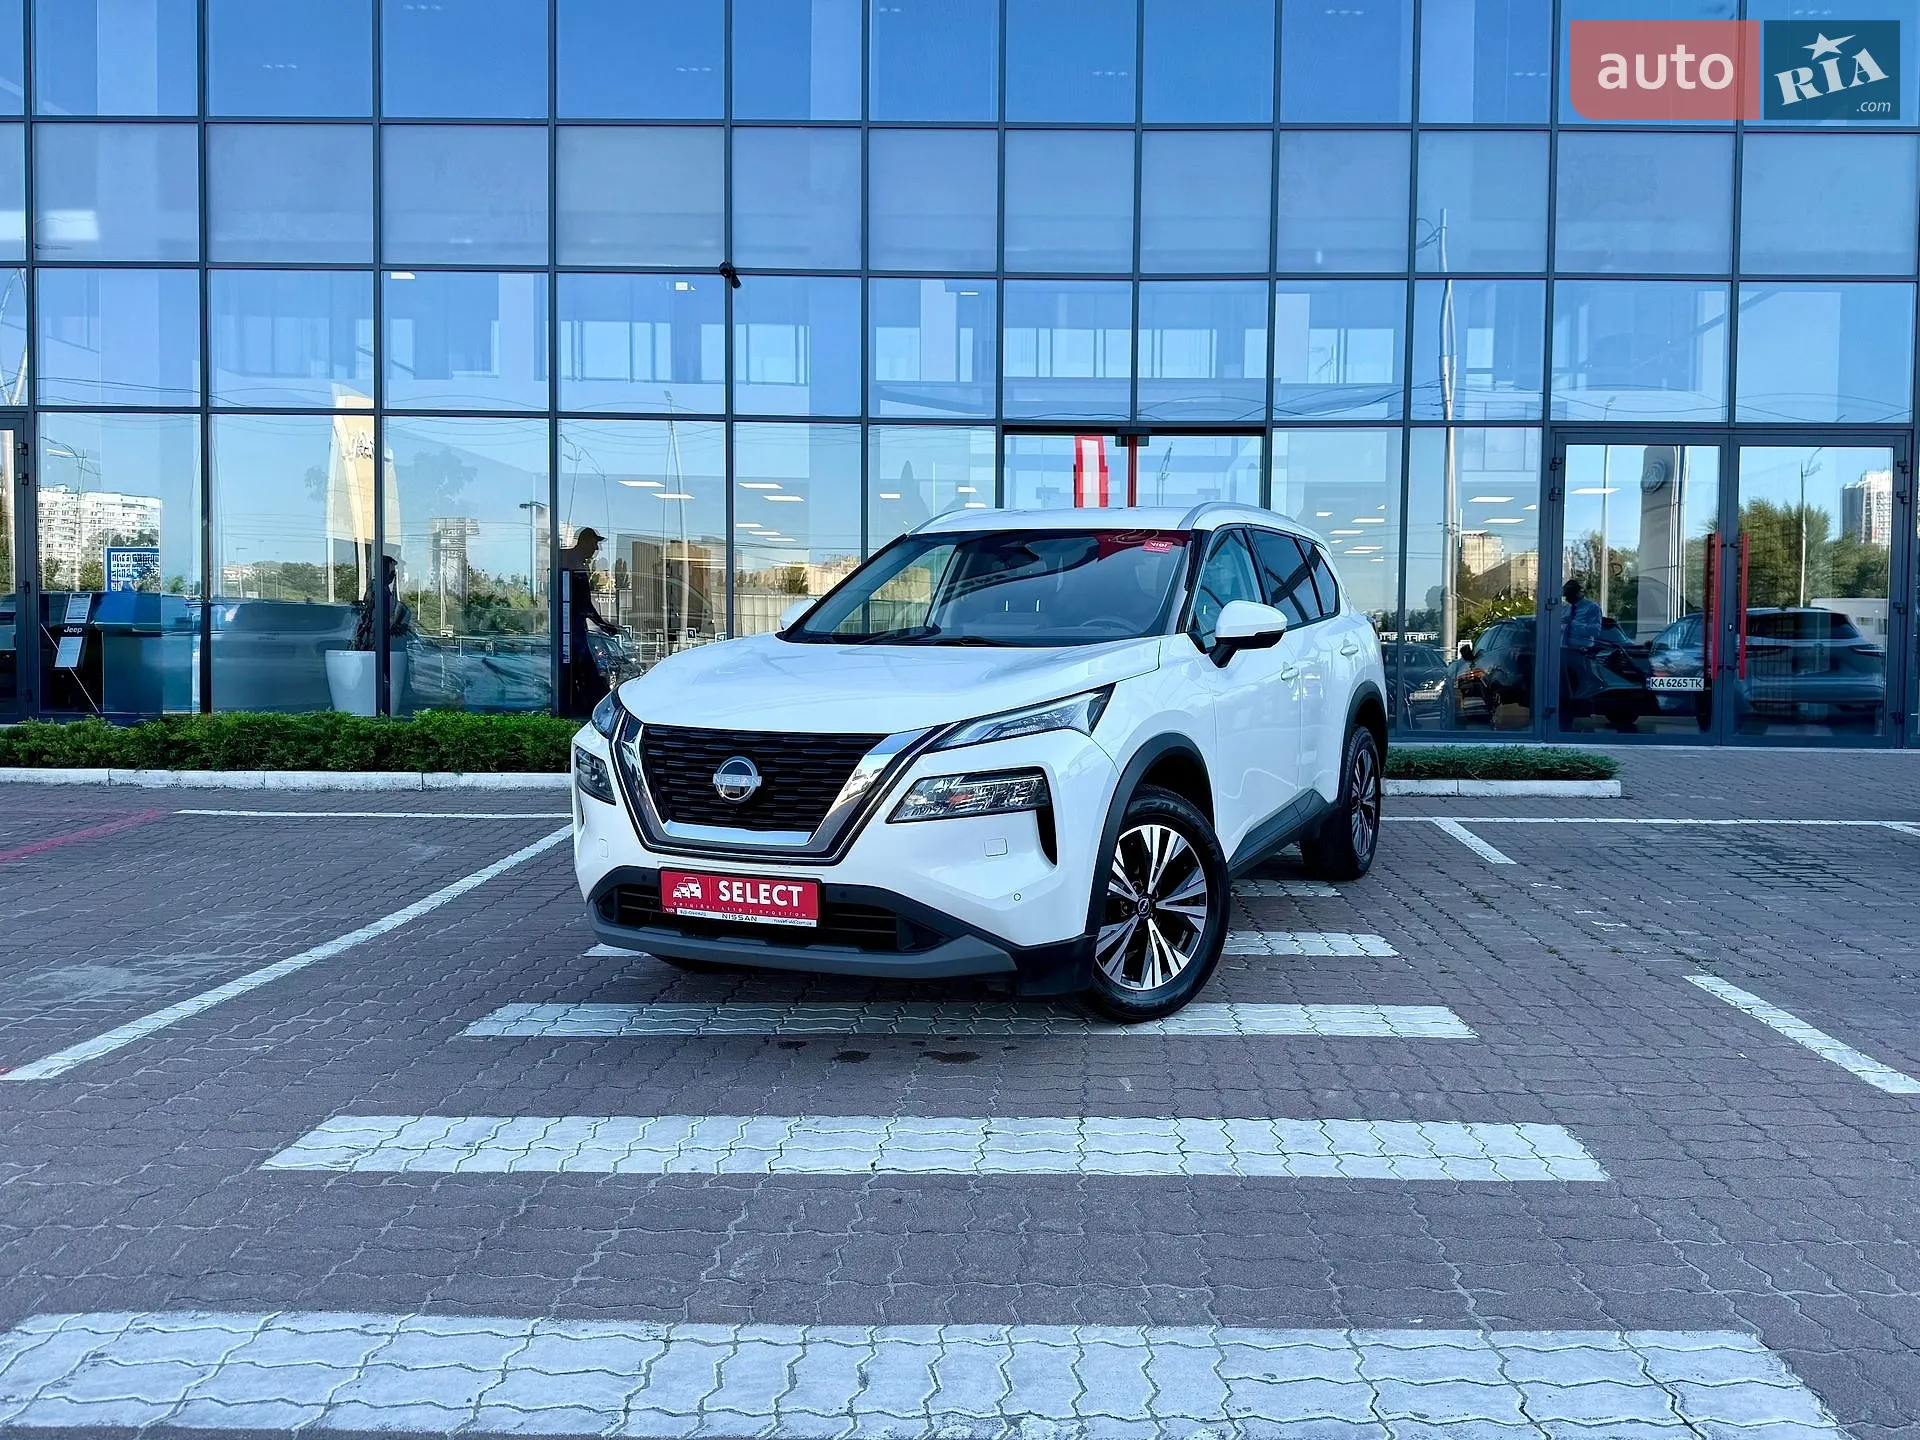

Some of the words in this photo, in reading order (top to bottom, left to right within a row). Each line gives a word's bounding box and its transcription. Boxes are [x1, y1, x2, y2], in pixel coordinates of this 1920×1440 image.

[63, 625, 83, 634] Jeep
[1651, 678, 1665, 688] KA
[1666, 678, 1688, 688] 6265
[1689, 679, 1702, 688] TK
[714, 774, 761, 786] NISSAN
[718, 880, 803, 907] SELECT
[721, 913, 758, 922] NISSAN
